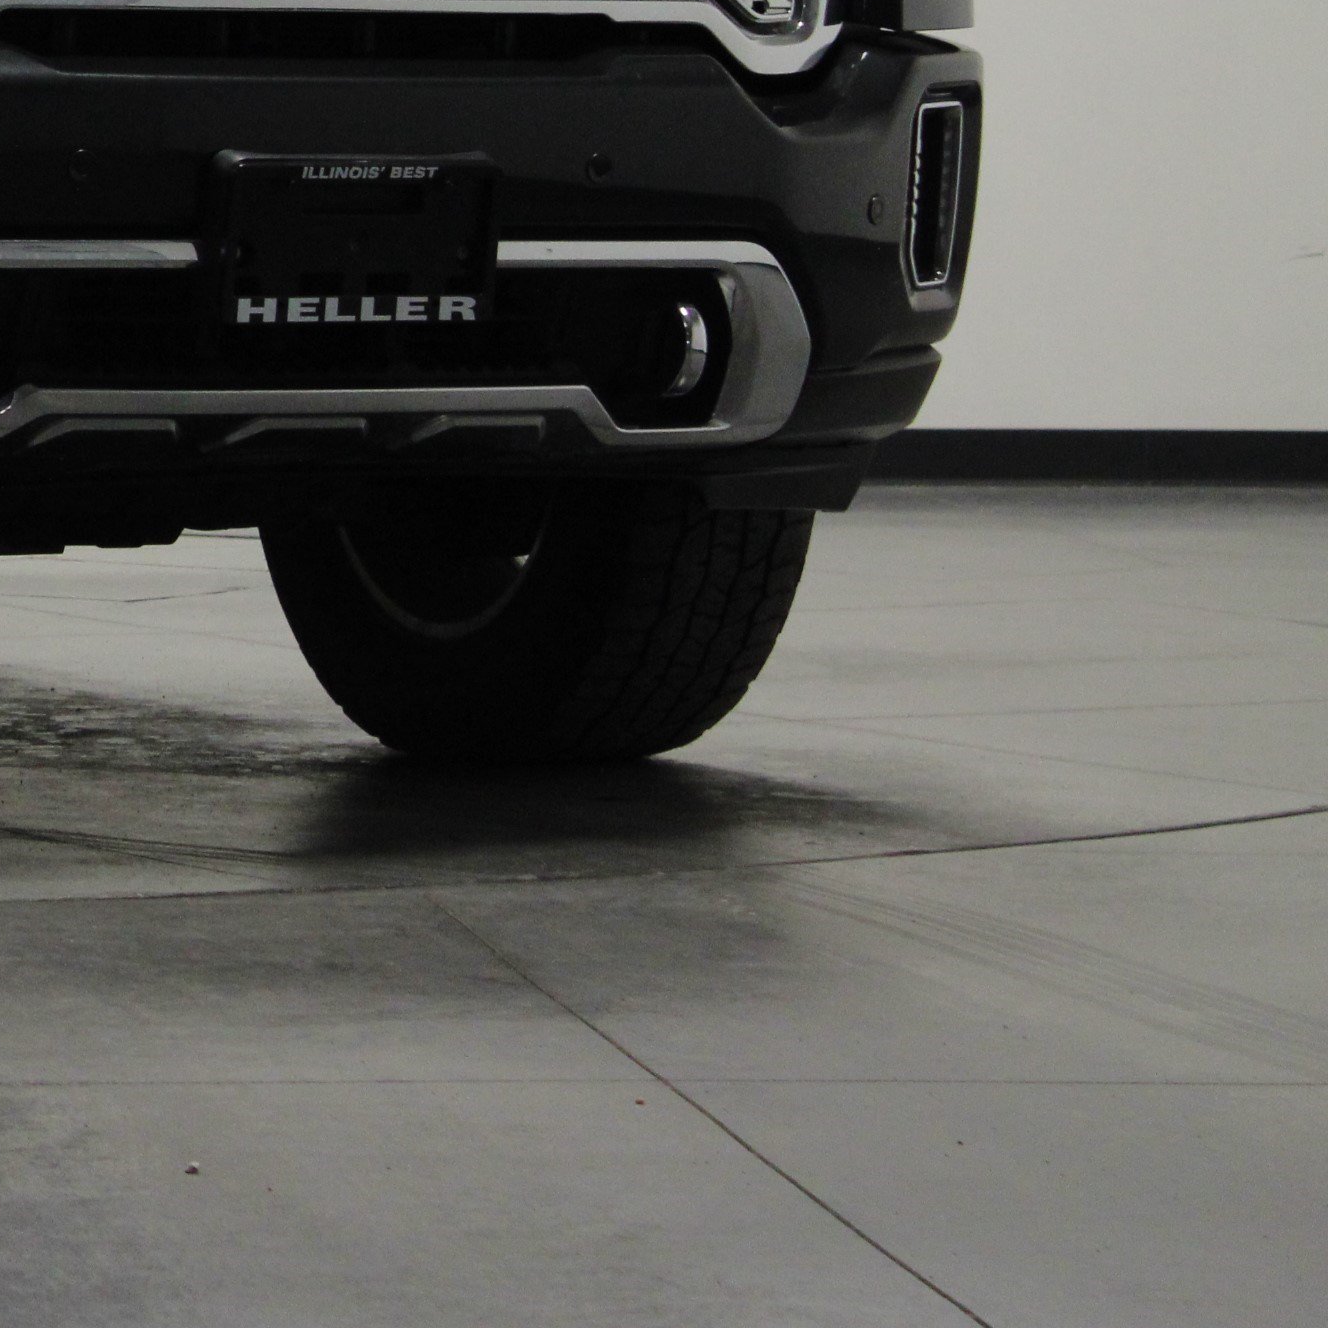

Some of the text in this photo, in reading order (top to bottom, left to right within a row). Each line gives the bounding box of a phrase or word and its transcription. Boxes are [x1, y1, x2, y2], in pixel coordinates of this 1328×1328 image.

[301, 166, 439, 179] ILLINOIS' BEST
[235, 296, 476, 323] HELLER
